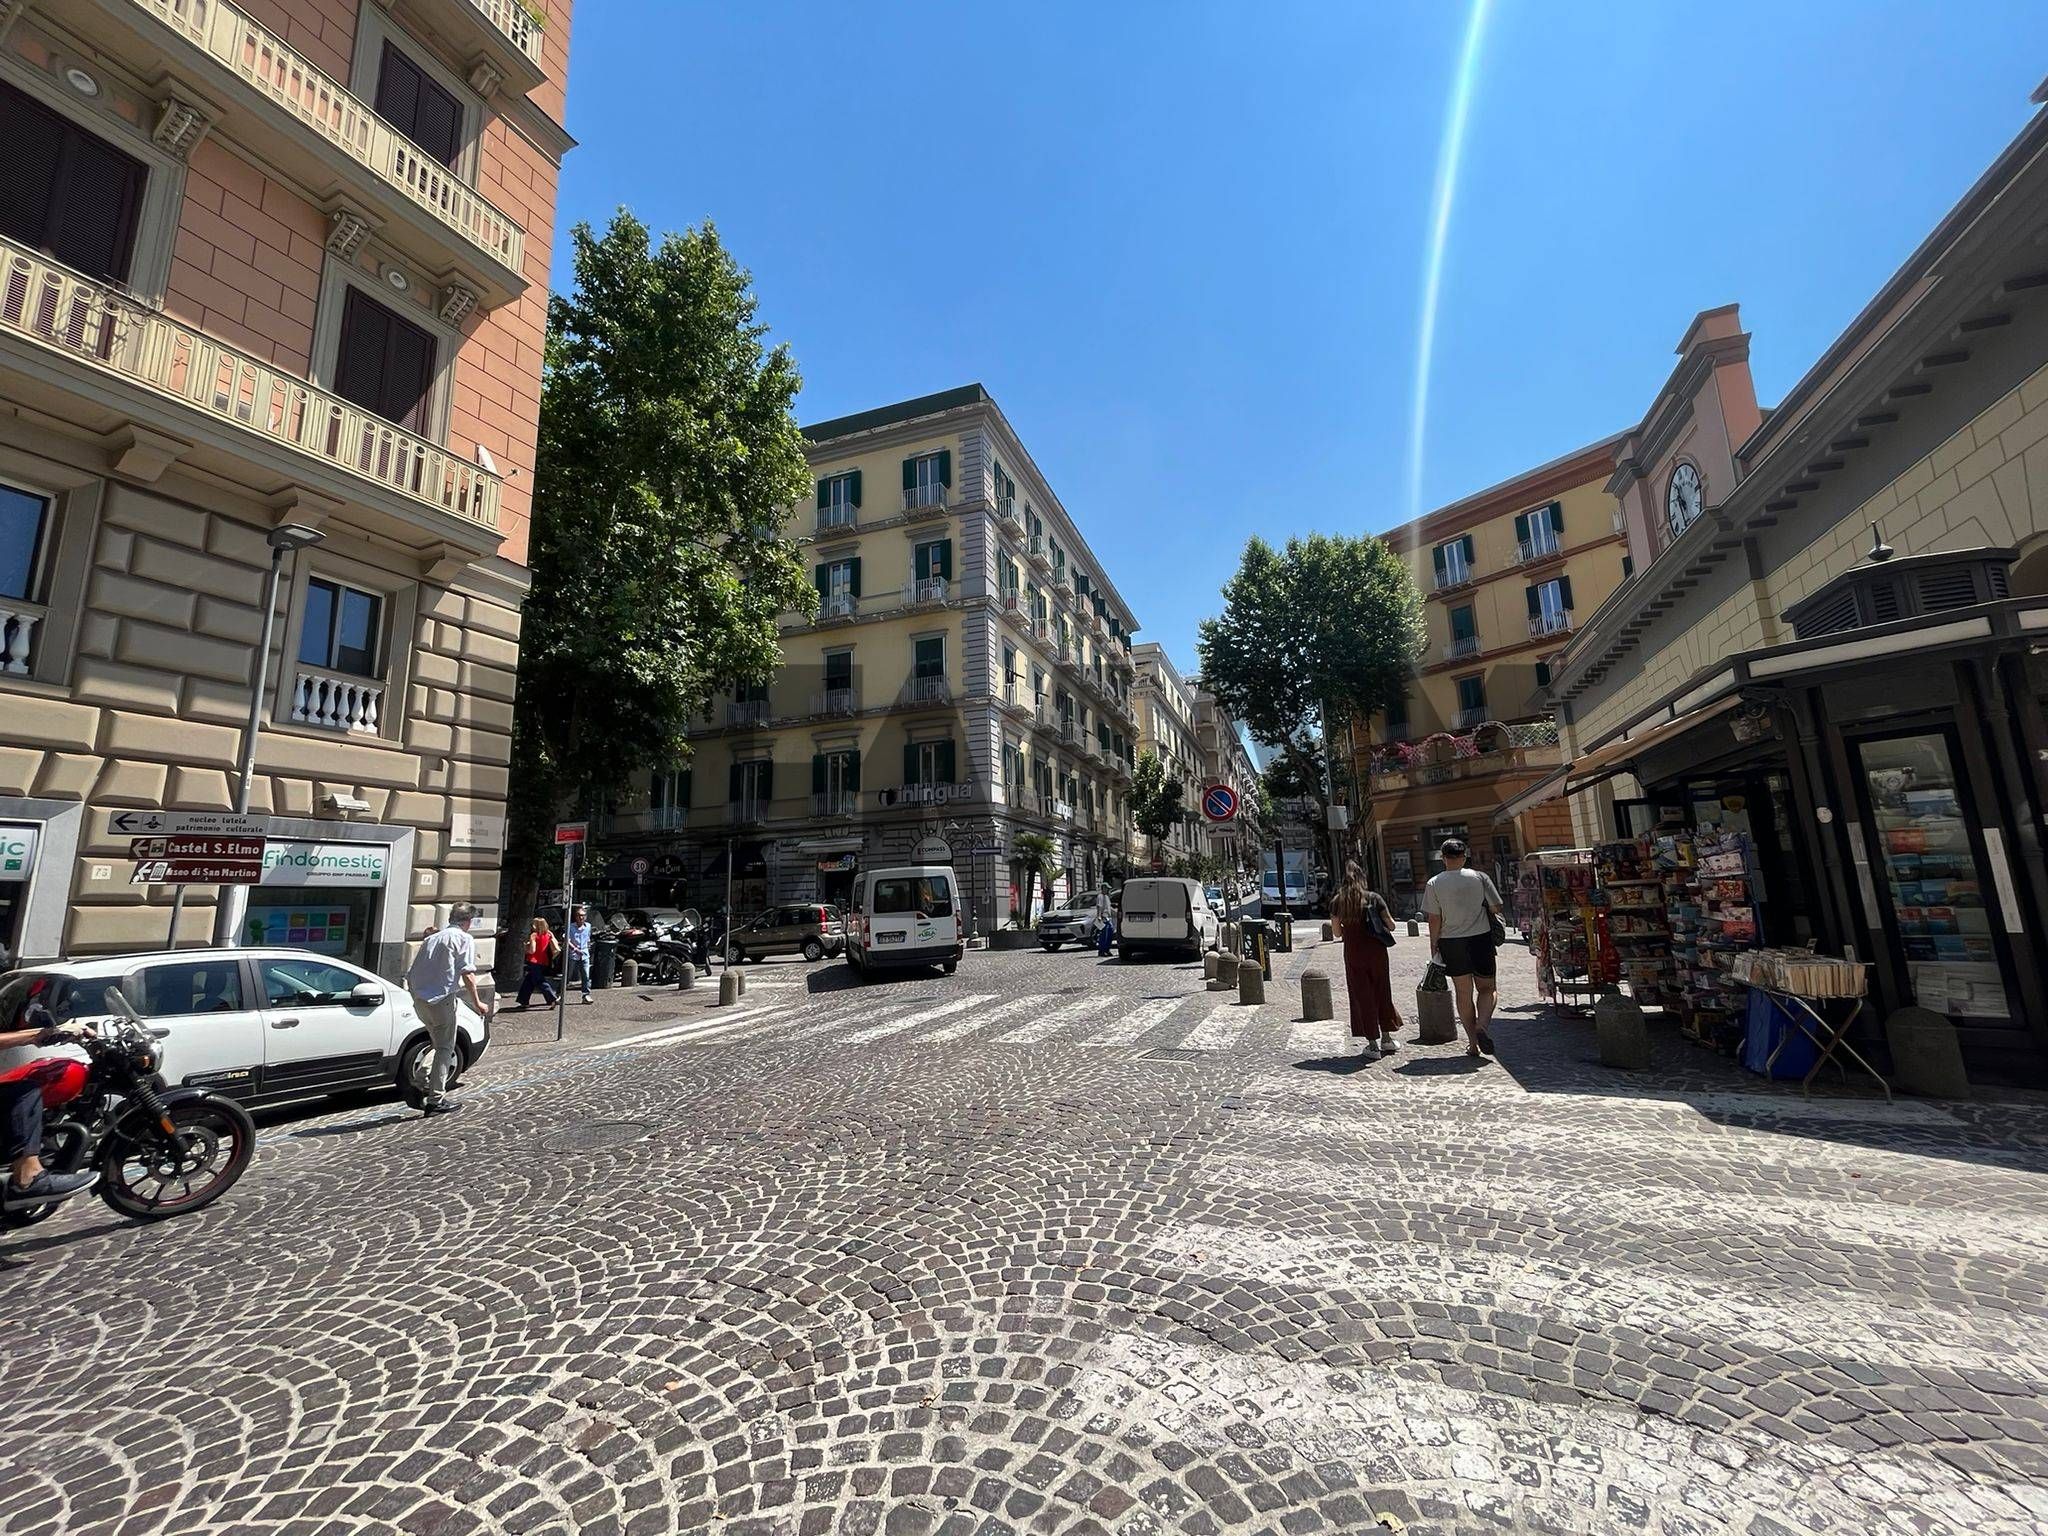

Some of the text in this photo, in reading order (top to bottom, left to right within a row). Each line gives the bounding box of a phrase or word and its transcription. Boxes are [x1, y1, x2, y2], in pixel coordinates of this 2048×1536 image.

[897, 783, 972, 804] inlingua
[189, 816, 247, 824] nucleo tutela
[175, 824, 263, 833] patrimonio culturale
[168, 842, 260, 855] Castel S.Elmo
[263, 849, 383, 869] Findomestic
[191, 867, 200, 876] di
[202, 868, 220, 877] San
[221, 868, 257, 877] Martino
